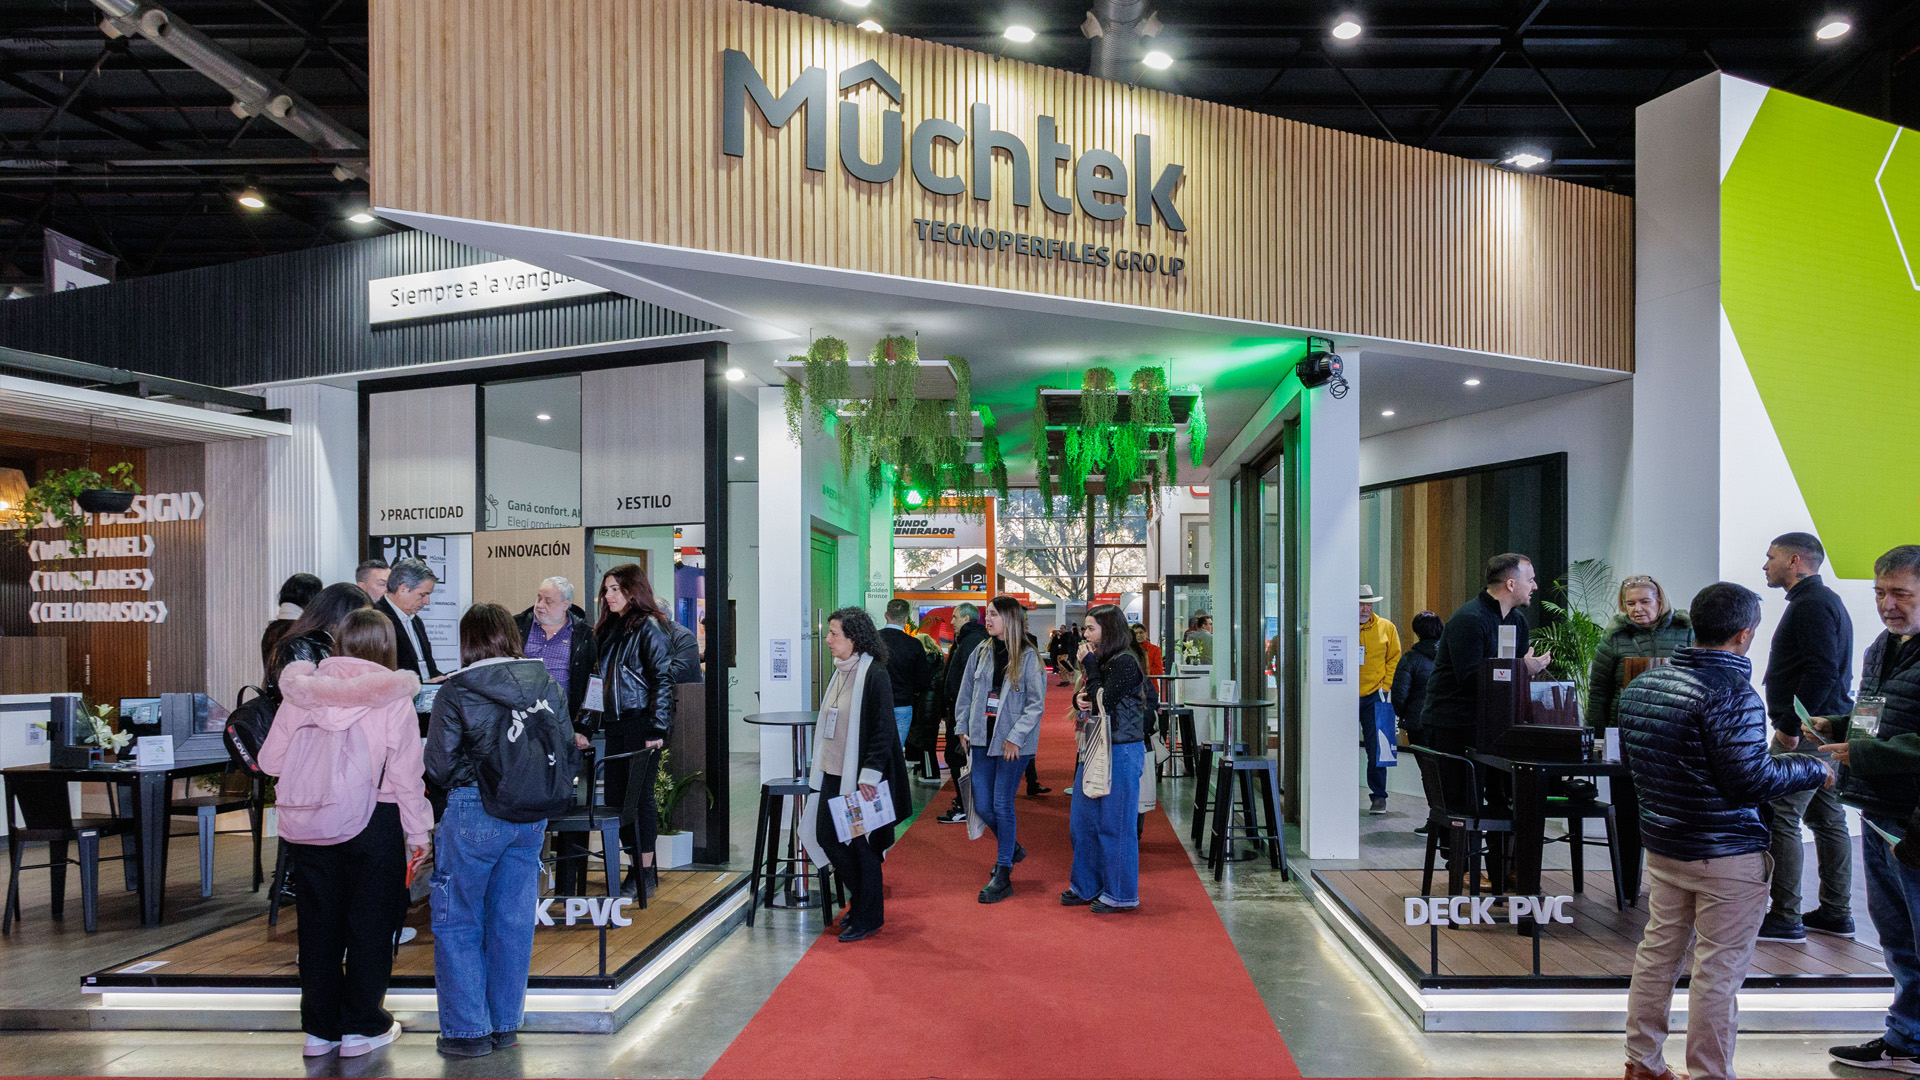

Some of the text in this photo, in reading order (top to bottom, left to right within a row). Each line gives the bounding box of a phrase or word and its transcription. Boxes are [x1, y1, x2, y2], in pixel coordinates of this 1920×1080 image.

[723, 48, 1187, 232] Mûchtek
[914, 218, 1186, 277] TECNOPERFILES GROUP
[390, 283, 464, 308] Siempre
[469, 281, 478, 296] a
[484, 274, 499, 294] la
[387, 505, 464, 521] PRACTICIDAD
[508, 500, 532, 512] Ganá
[534, 504, 570, 518] confort.
[625, 494, 672, 510] ESTILO
[86, 536, 145, 558] PANEL
[495, 540, 570, 558] INNOVACIÓN
[40, 568, 144, 590] TUBULARES
[40, 601, 158, 622] CIELORRASOS
[233, 737, 250, 762] LOVE
[566, 898, 633, 926] PVC
[1404, 896, 1574, 926] DECK PVC
